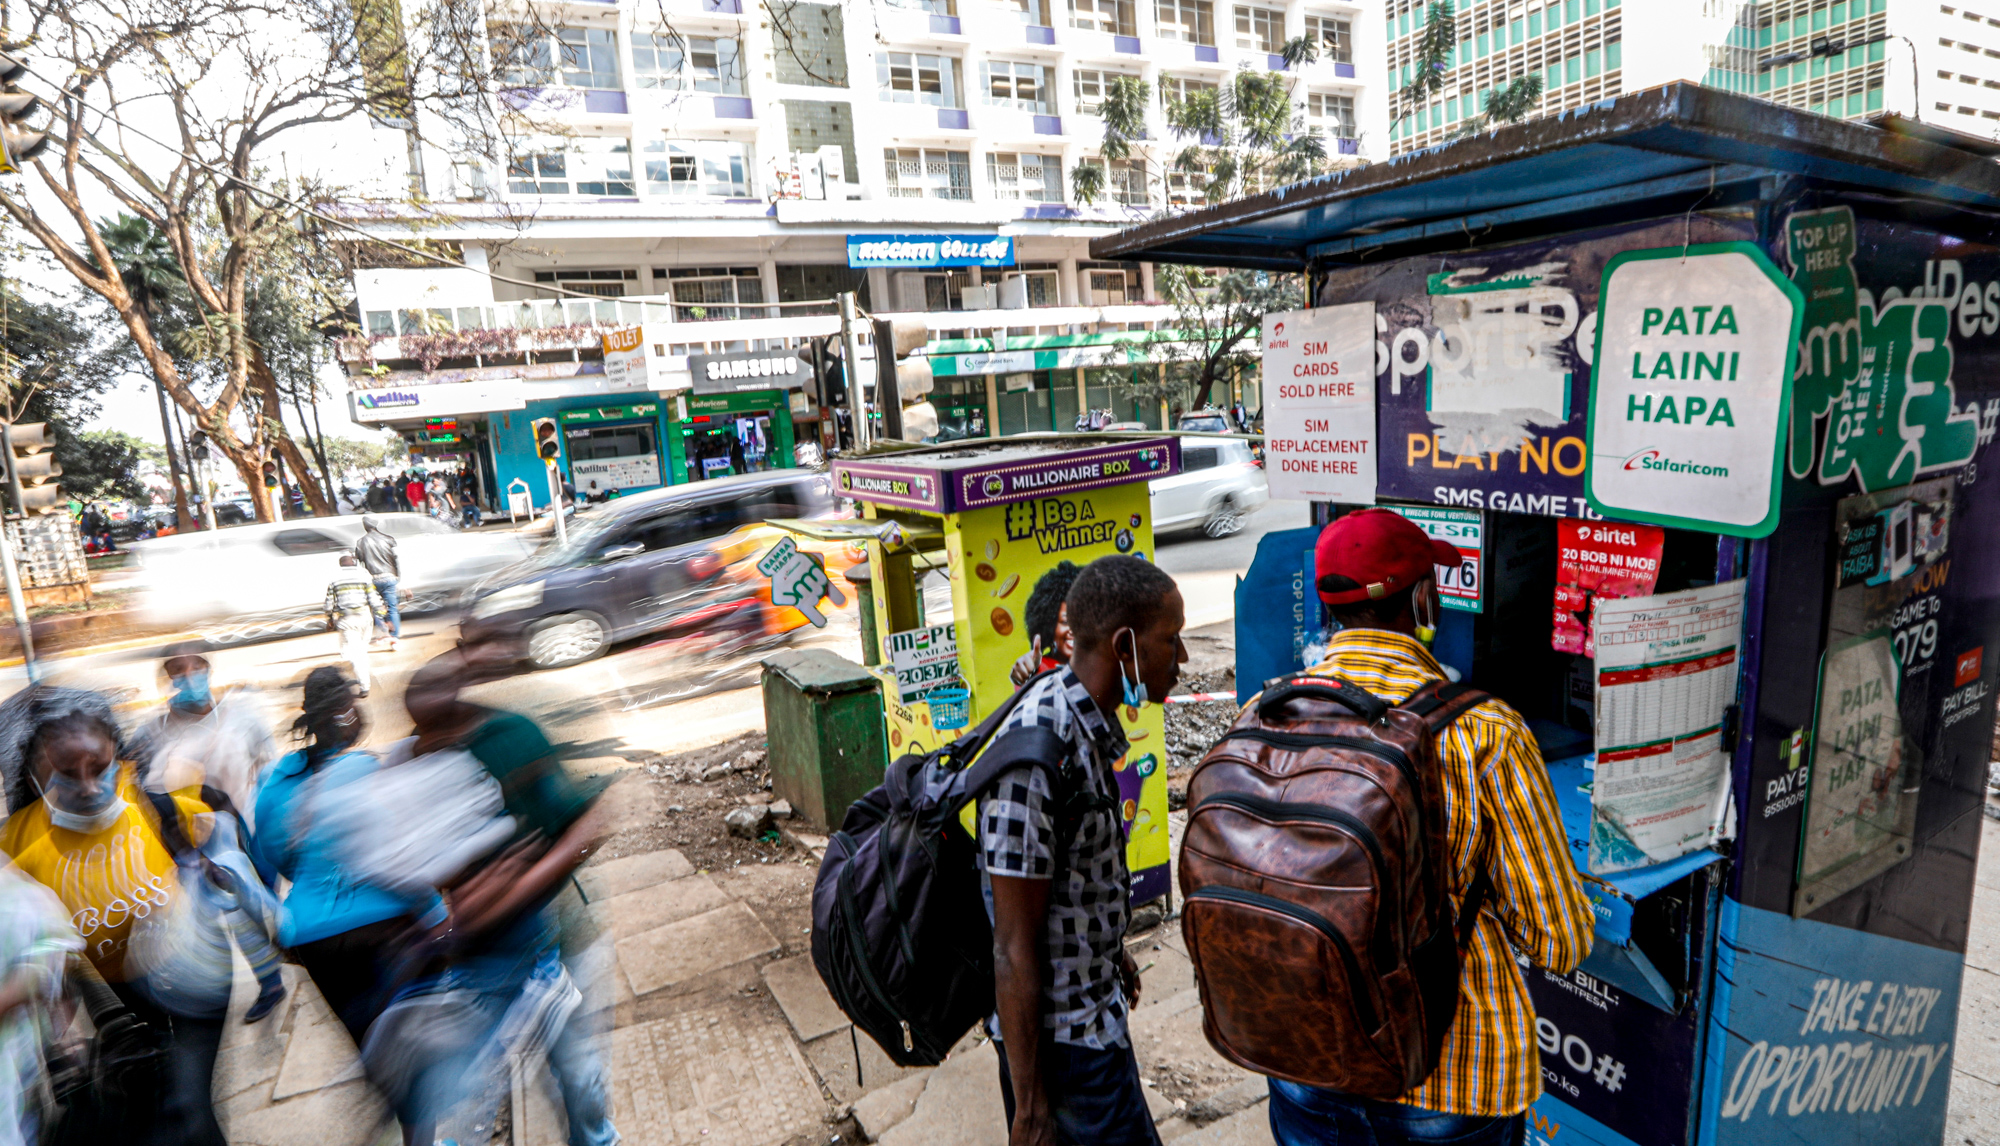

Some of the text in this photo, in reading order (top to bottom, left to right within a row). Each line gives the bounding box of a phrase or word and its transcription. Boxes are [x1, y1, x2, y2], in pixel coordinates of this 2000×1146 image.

[1794, 224, 1847, 249] TOP UP
[941, 240, 1008, 259] COLLEGE
[1805, 249, 1841, 272] HERE
[1641, 305, 1739, 336] PATA
[608, 329, 637, 350] TO LET
[1269, 340, 1289, 349] airtel
[1303, 341, 1328, 356] SIM
[706, 357, 798, 380] SAMSUNG
[1293, 361, 1339, 377] CARDS
[1632, 352, 1740, 381] LAINI
[1280, 382, 1355, 398] SOLD HERE
[1877, 340, 1895, 419] Safaricom
[1851, 346, 1876, 437] HERE
[691, 400, 728, 408] Safaricom
[1627, 394, 1735, 427] HAPA
[1304, 419, 1329, 432] SIM
[1831, 384, 1856, 465] TOP
[1271, 439, 1368, 454] REPLACEMENT
[1012, 464, 1100, 490] MILLIONAIRE
[1103, 459, 1131, 475] BOX
[1282, 459, 1358, 475] DONE HERE
[1642, 456, 1729, 477] Safaricom
[1957, 464, 1977, 486] +18
[852, 476, 893, 493] MILLIONAIRE
[892, 481, 909, 495] BOX
[1045, 499, 1076, 525] Be
[1077, 498, 1095, 519] A
[1434, 486, 1484, 508] SMS
[1489, 490, 1567, 517] GAME
[1431, 510, 1446, 519] FONE
[1448, 511, 1480, 521] VENTURES
[1034, 518, 1116, 554] Winner
[1593, 527, 1636, 546] airtel
[1847, 524, 1877, 543] ASK US
[764, 543, 791, 570] BAMBA
[1562, 548, 1656, 571] 20 BOB NI MOB
[1849, 541, 1872, 556] ABOUT
[772, 552, 794, 573] HAPA
[1562, 561, 1584, 571] PATA
[1631, 572, 1653, 581] HAPA
[1842, 554, 1875, 579] FAIBA
[1442, 597, 1478, 609] ORIGINAL ID
[1556, 591, 1568, 601] 20
[1293, 570, 1304, 662] TOP UP HERE
[1555, 613, 1567, 623] 20
[1891, 601, 1926, 629] GAME
[1929, 595, 1940, 614] To
[1554, 634, 1566, 644] 20
[1683, 634, 1707, 645] TARIFFS
[1841, 678, 1883, 716] PATA
[1941, 691, 1964, 717] PAY
[1945, 702, 1980, 728] SPORTPESA
[1767, 772, 1797, 801] PAY
[69, 876, 172, 937] BOSS
[1544, 970, 1608, 1012] SPORTPESA
[1575, 970, 1619, 1006] BILL:
[1801, 978, 1942, 1036] TAKE EVERY
[1721, 1040, 1949, 1122] OPPORTUNITY
